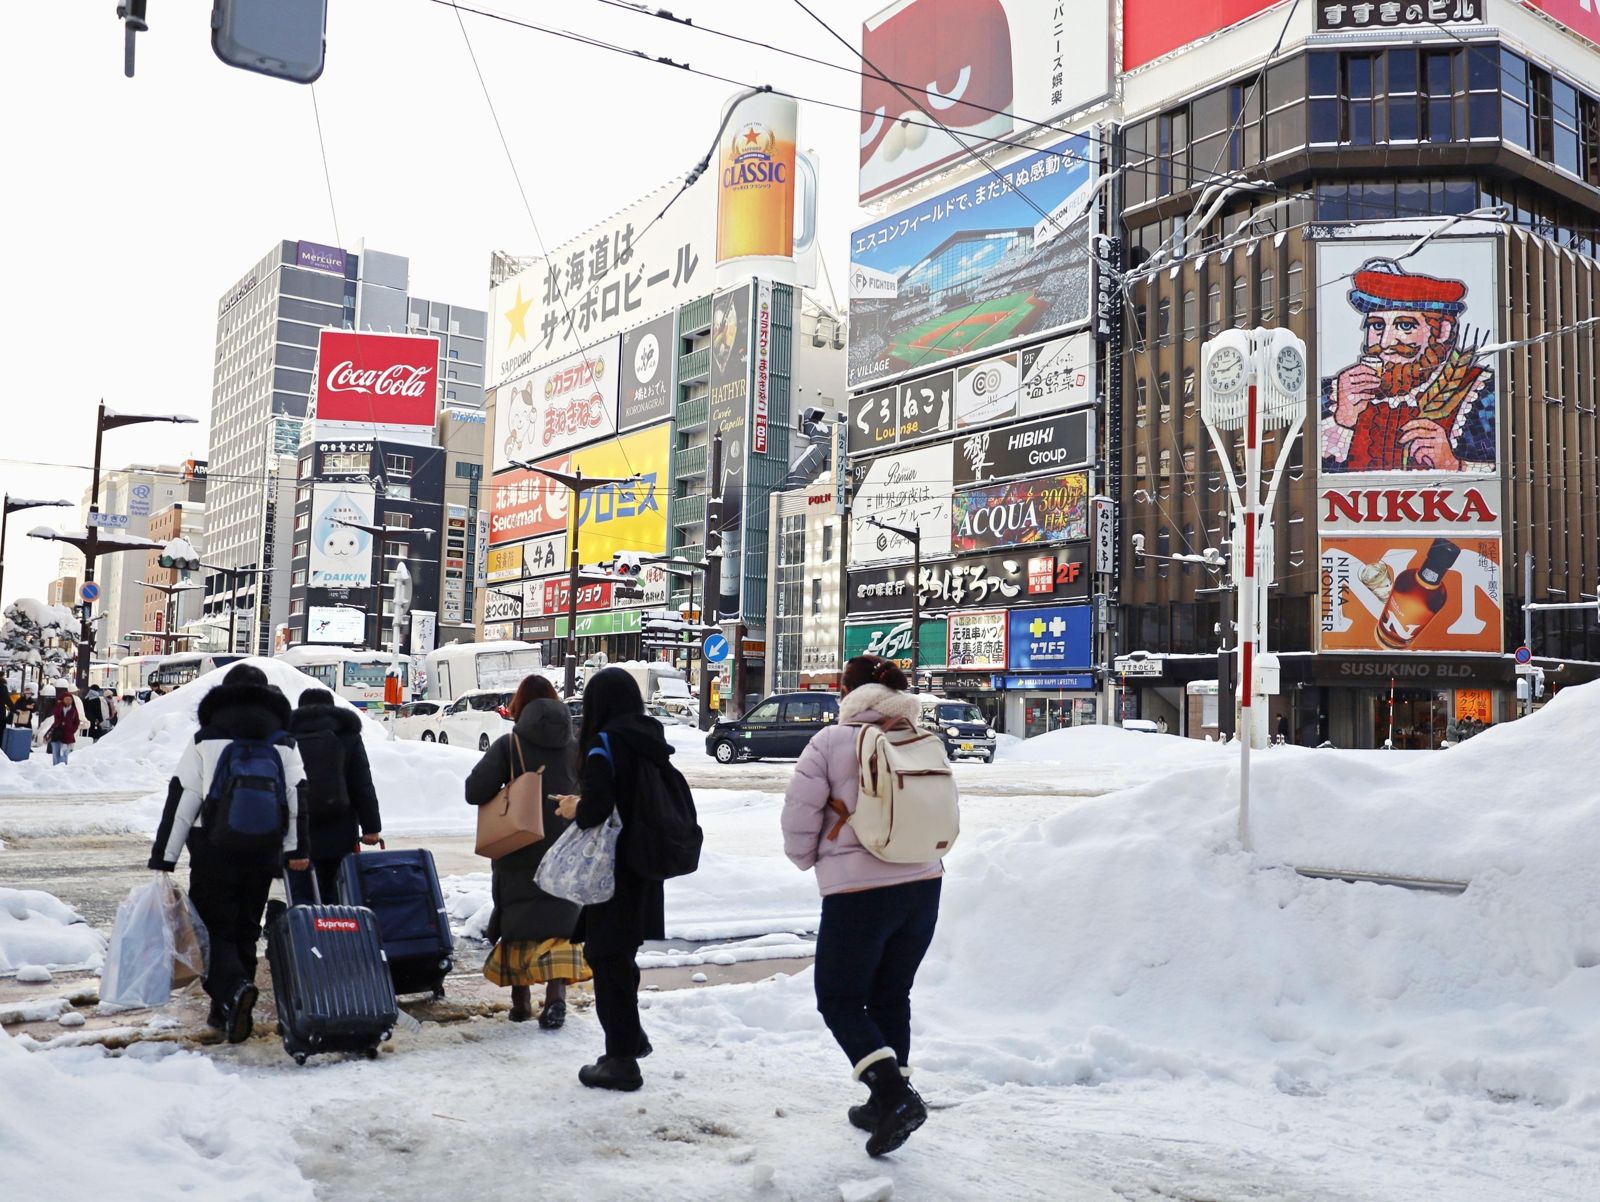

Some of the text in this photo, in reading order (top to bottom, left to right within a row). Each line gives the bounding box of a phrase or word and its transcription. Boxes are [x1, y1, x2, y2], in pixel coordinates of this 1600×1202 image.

[1324, 0, 1474, 24] すすきのビル
[723, 161, 786, 188] CLASSIC
[855, 149, 1083, 254] エスコンフィールドで、まだ見ぬ感動を。
[302, 252, 342, 267] Mercure
[543, 222, 634, 306] 北海道は
[869, 276, 896, 291] FIGHTERS
[541, 243, 698, 350] サッポロビール
[760, 311, 769, 348] カラオケ
[500, 350, 532, 376] SAPPORO
[856, 360, 890, 378] VILLAGE
[1024, 353, 1035, 366] 2F
[326, 361, 432, 397] Coca-Cola
[552, 358, 596, 396] カラオケ
[712, 378, 746, 405] HATHYR
[542, 392, 602, 446] まねきねこ
[713, 404, 732, 421] Cuvée
[856, 387, 934, 434] くろねこ
[720, 416, 744, 432] Capella
[876, 420, 918, 441] Lounge
[756, 426, 766, 448] 8F
[1008, 427, 1054, 450] HIBIKI
[1028, 448, 1067, 466] Group
[837, 456, 845, 504] グリーンビル
[856, 466, 866, 480] 9F
[884, 462, 917, 486] Premier
[496, 477, 540, 511] 北海道は
[1321, 488, 1498, 523] NIKKA
[92, 514, 128, 524] すすきの
[492, 505, 542, 532] Seicomart
[957, 500, 1038, 538] ACQUA
[478, 538, 487, 580] グリーンビル
[532, 542, 555, 568] 牛角
[323, 573, 367, 581] DAIKIN
[906, 560, 1021, 606] さっぽろっこ
[1056, 562, 1082, 584] 2F
[1338, 558, 1350, 606] NIKKA
[1321, 557, 1333, 632] FRONTIER
[952, 626, 997, 640] 元祖串かつ
[952, 641, 1003, 654] 恵美須商店
[1030, 642, 1065, 653] サツドラ
[1341, 663, 1476, 678] SUSUKINO BLD.
[318, 919, 356, 928] Supreme
